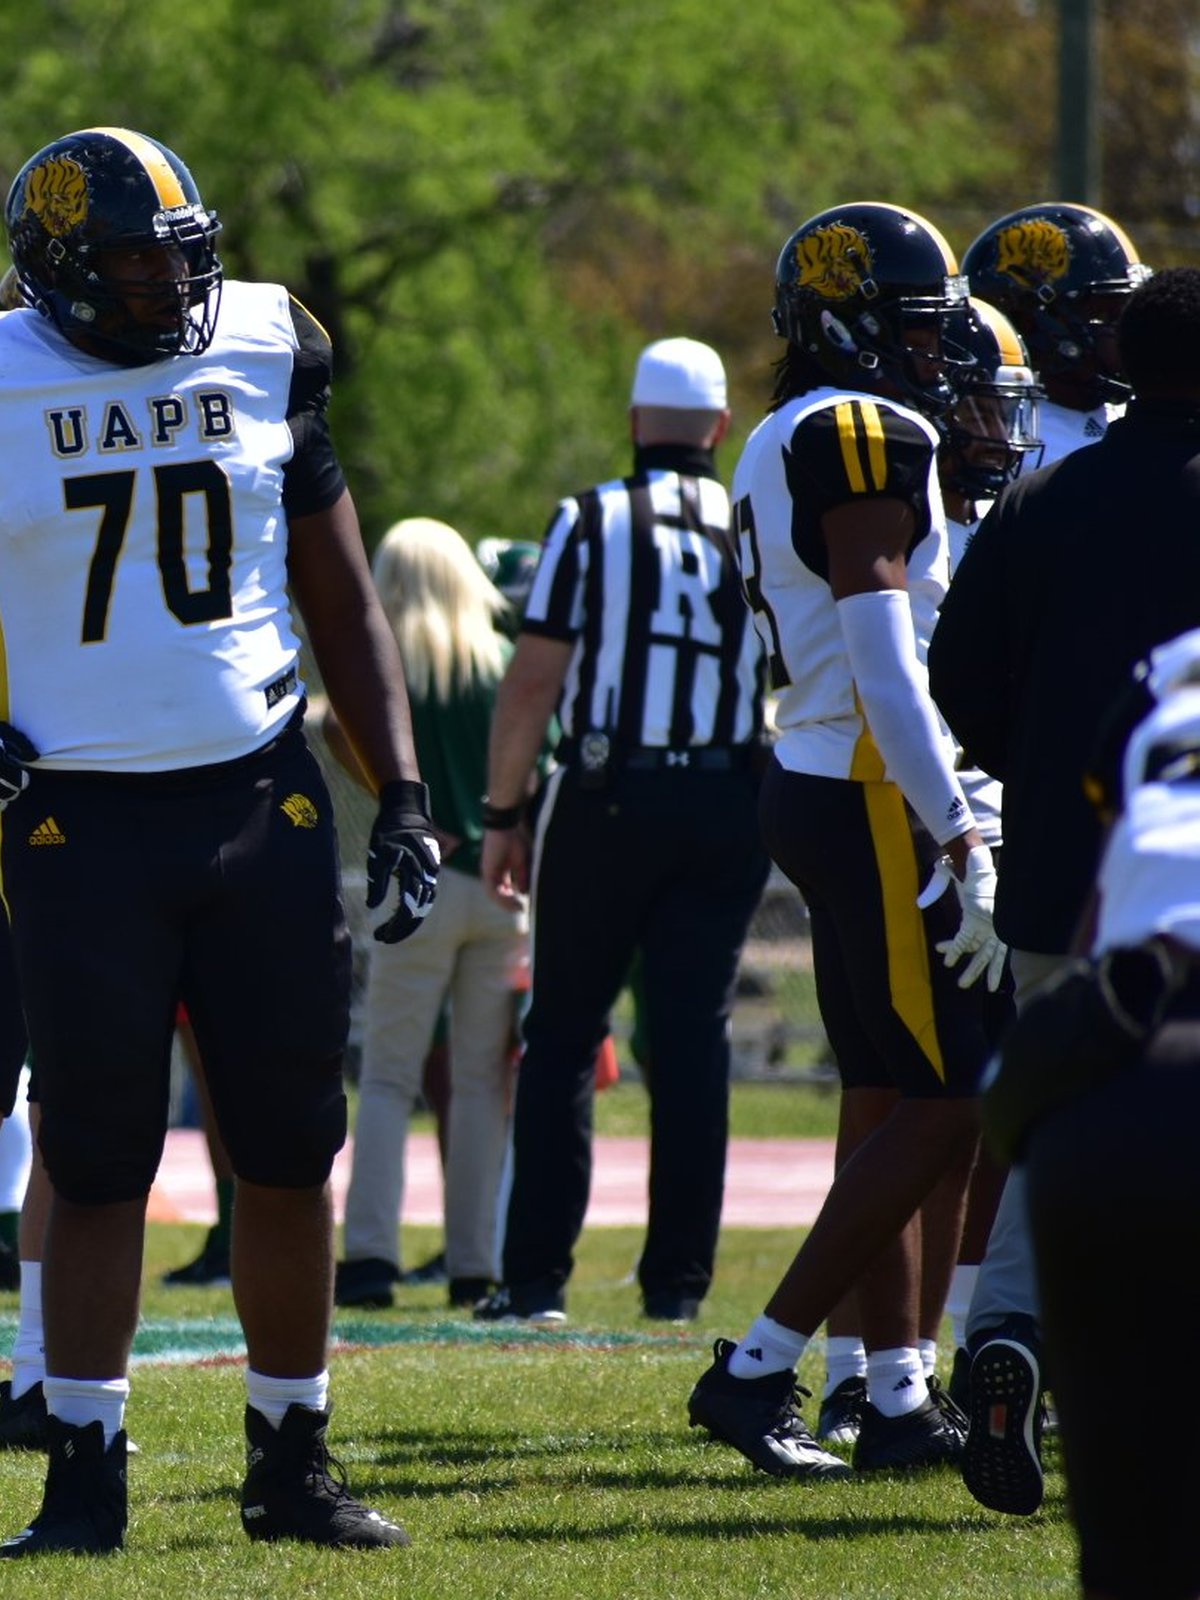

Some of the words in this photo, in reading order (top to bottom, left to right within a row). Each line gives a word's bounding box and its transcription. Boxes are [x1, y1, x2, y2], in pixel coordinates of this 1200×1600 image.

[45, 389, 236, 458] UAPB
[63, 459, 233, 646] 70
[651, 524, 722, 648] R
[28, 834, 66, 846] adidas
